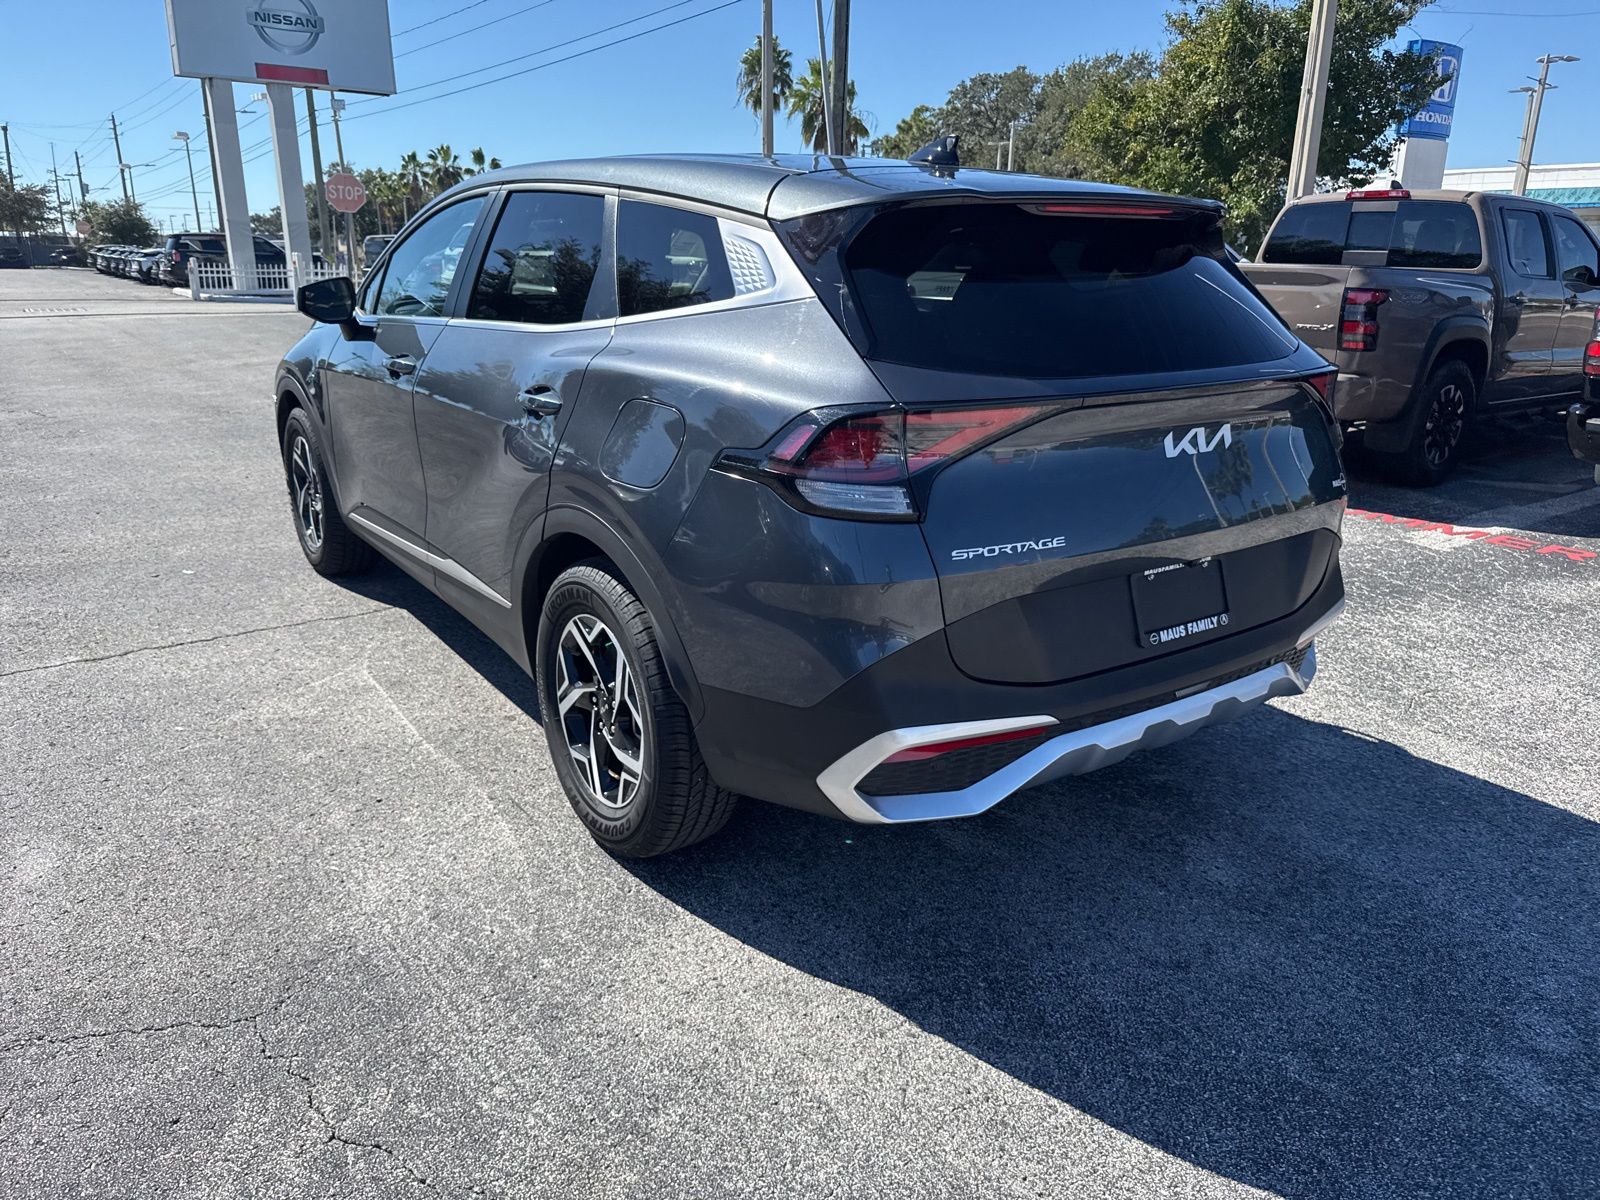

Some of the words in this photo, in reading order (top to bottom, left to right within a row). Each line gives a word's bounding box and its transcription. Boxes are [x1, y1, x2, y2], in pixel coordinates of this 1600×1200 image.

[254, 11, 318, 29] NISSAN
[328, 184, 363, 201] STOP
[1163, 423, 1232, 459] KIA
[951, 536, 1067, 561] SPORTAGE
[1159, 625, 1186, 643] MAUS
[1187, 616, 1218, 635] FAMILY
